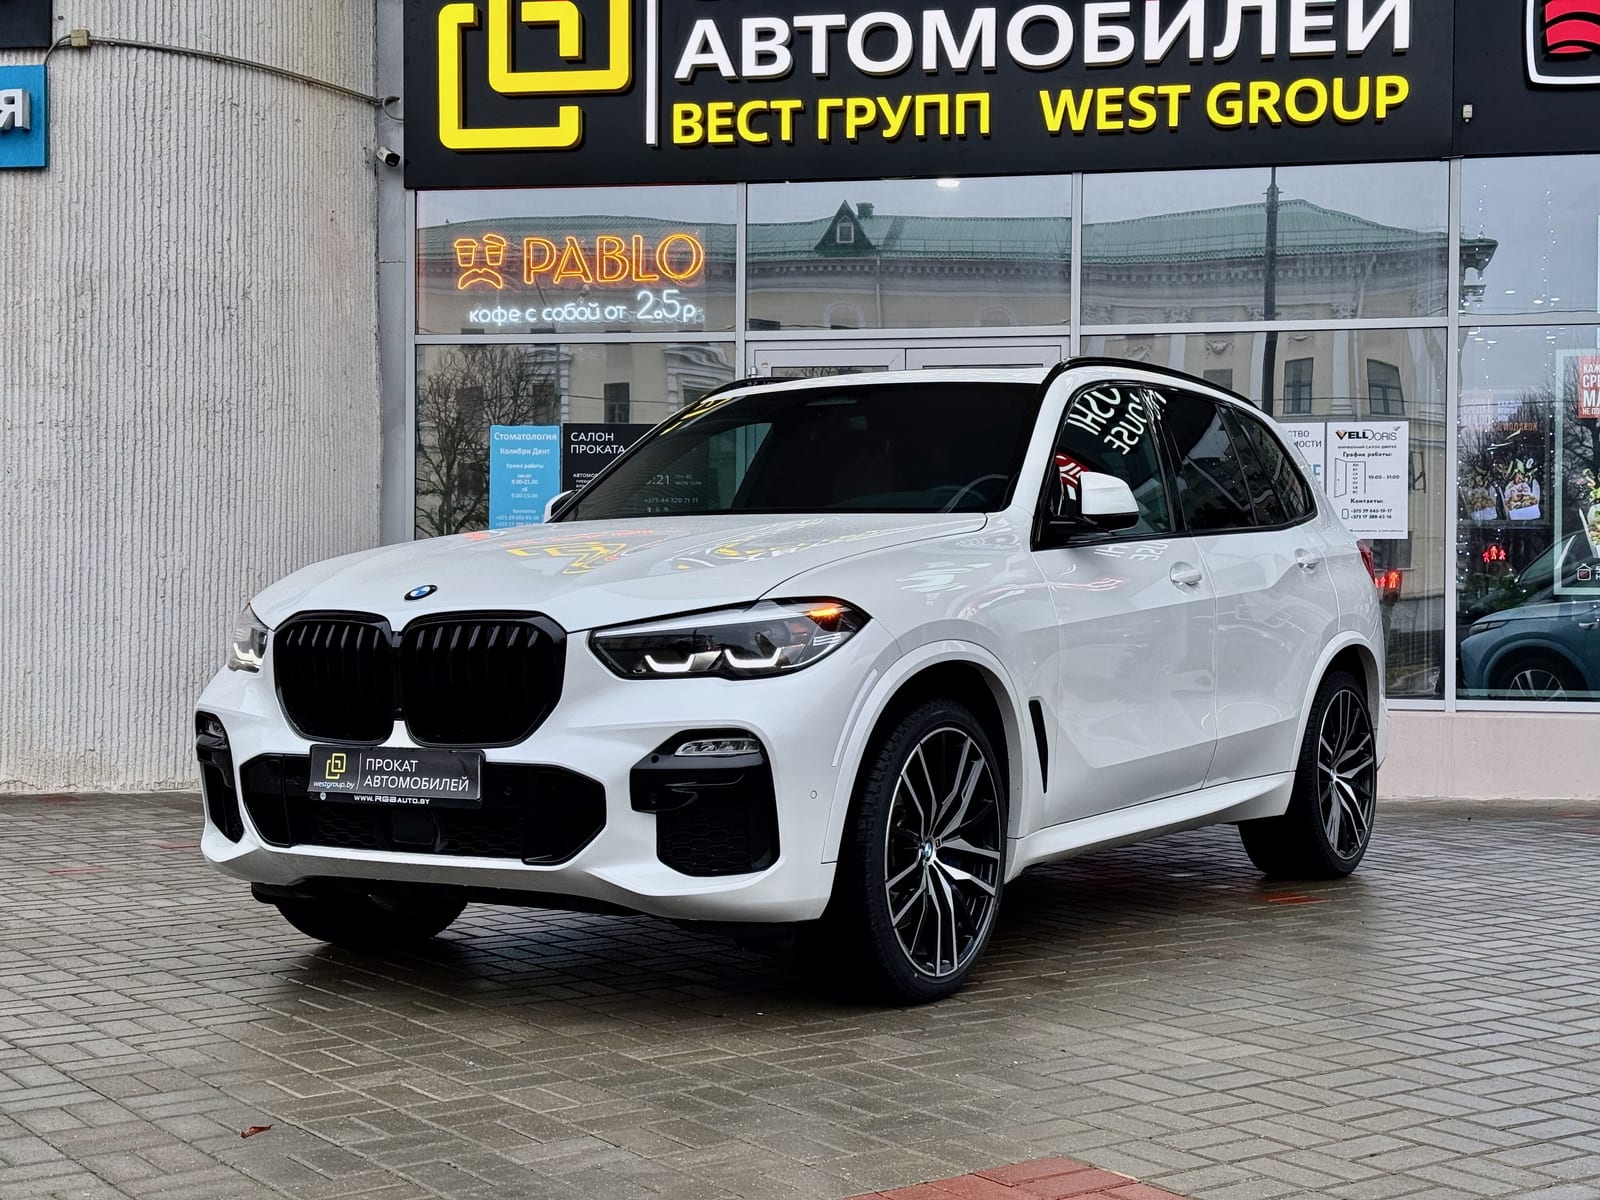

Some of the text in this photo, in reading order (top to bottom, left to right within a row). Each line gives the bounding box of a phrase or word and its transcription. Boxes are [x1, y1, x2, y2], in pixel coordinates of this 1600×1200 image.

[674, 0, 1411, 82] АВТОМОБИЛЕЙ
[1040, 74, 1411, 136] WEST GROUP
[672, 92, 991, 146] ВЕСТ ГРУПП
[523, 233, 704, 285] PABLO
[469, 305, 522, 327] кофе
[525, 307, 537, 322] с
[542, 302, 600, 321] собой
[604, 305, 627, 320] от
[494, 432, 557, 440] Стоматология
[570, 432, 615, 442] САЛОН
[532, 447, 550, 456] Дент
[570, 444, 625, 455] ПРОКАТА
[366, 758, 418, 773] ПРОКАТ
[313, 781, 356, 790] westgroup.by
[363, 775, 470, 792] АВТОМОБИЛЕЙ
